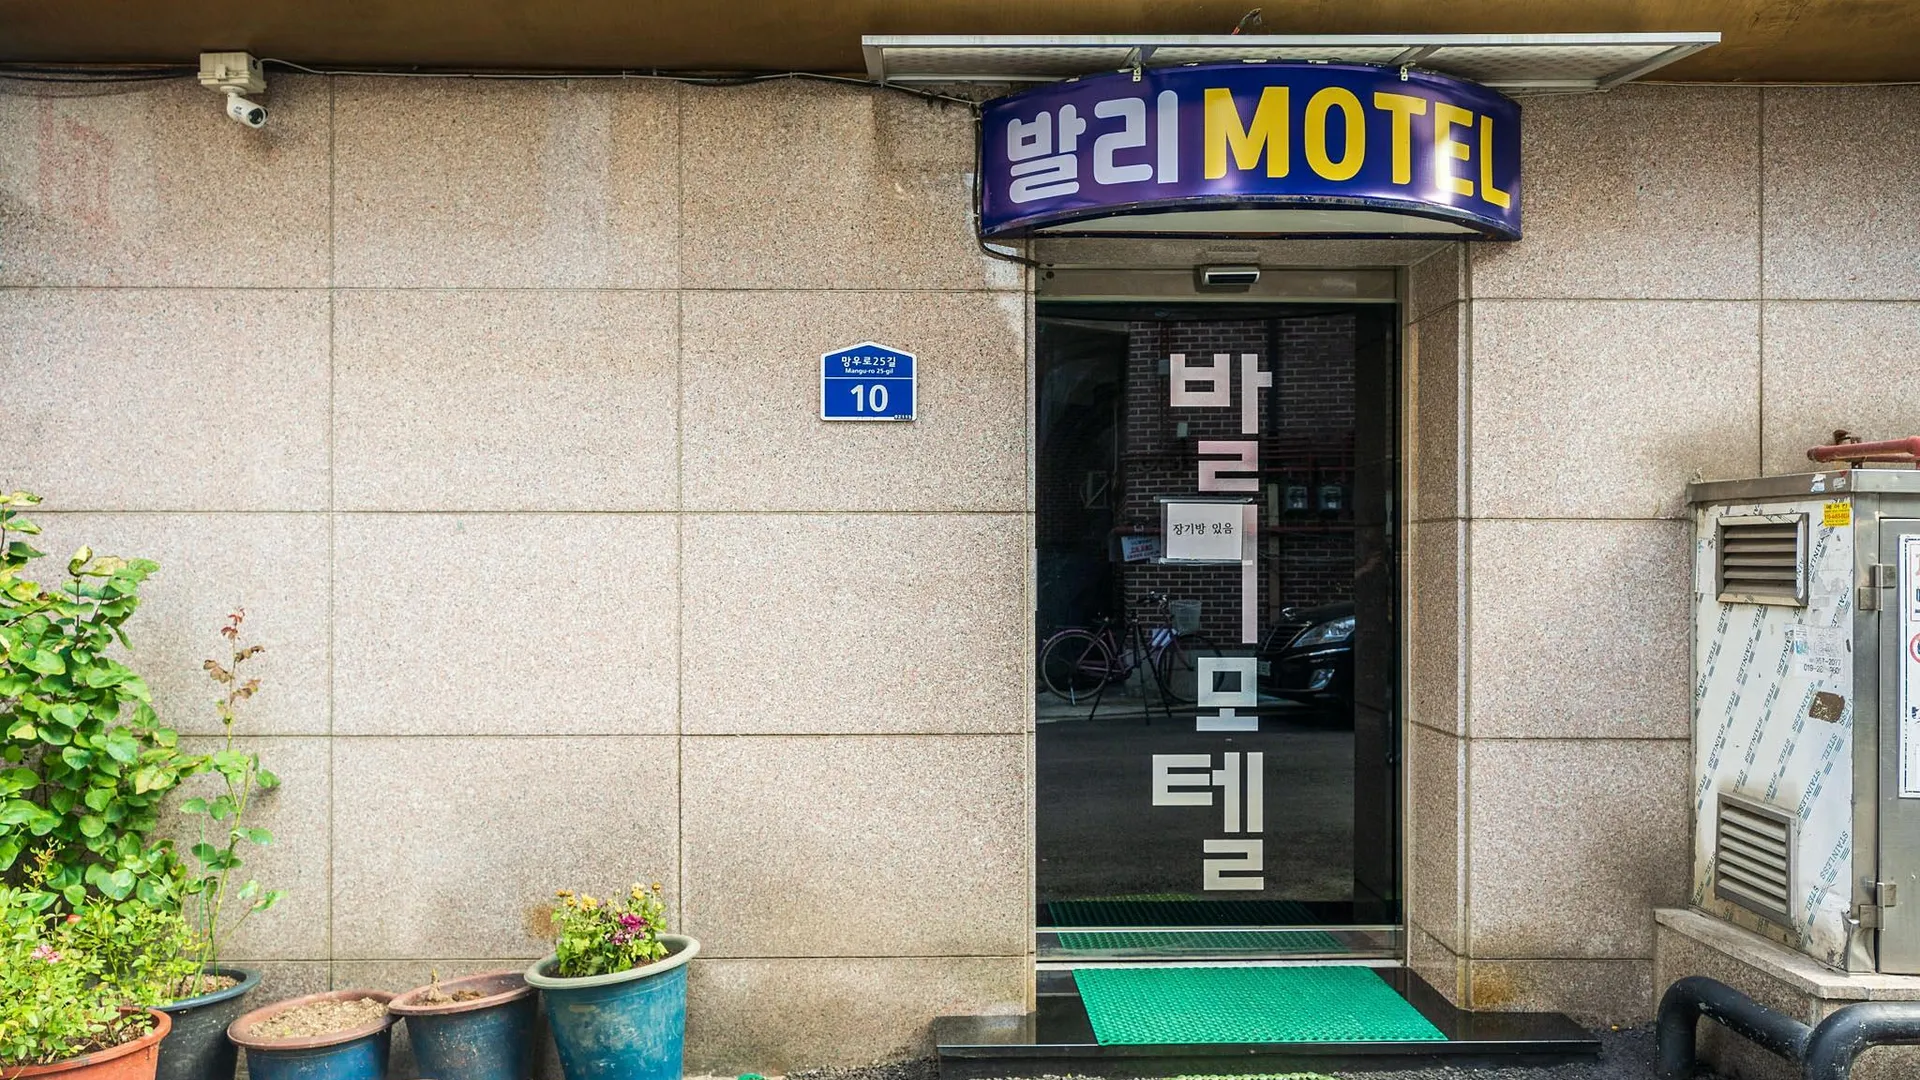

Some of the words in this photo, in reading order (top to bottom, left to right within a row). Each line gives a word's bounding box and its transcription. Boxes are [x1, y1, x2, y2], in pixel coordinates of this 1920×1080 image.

[1007, 89, 1179, 204] 발리
[1203, 86, 1511, 210] MOTEL
[841, 356, 896, 367] 망우로25길
[850, 384, 889, 412] 10
[1172, 522, 1206, 536] 장기방
[1211, 522, 1234, 535] 있음
[1736, 637, 1753, 683] STAINLESS
[1792, 682, 1815, 731] STAINLESS
[1708, 723, 1725, 768] STAINLESS
[1745, 717, 1763, 763] STAINLESS
[1822, 733, 1837, 760] STEEL
[1795, 771, 1820, 817] STAINLESS
[1820, 831, 1848, 879] STAINLESS
[1805, 885, 1819, 911] STEEL
